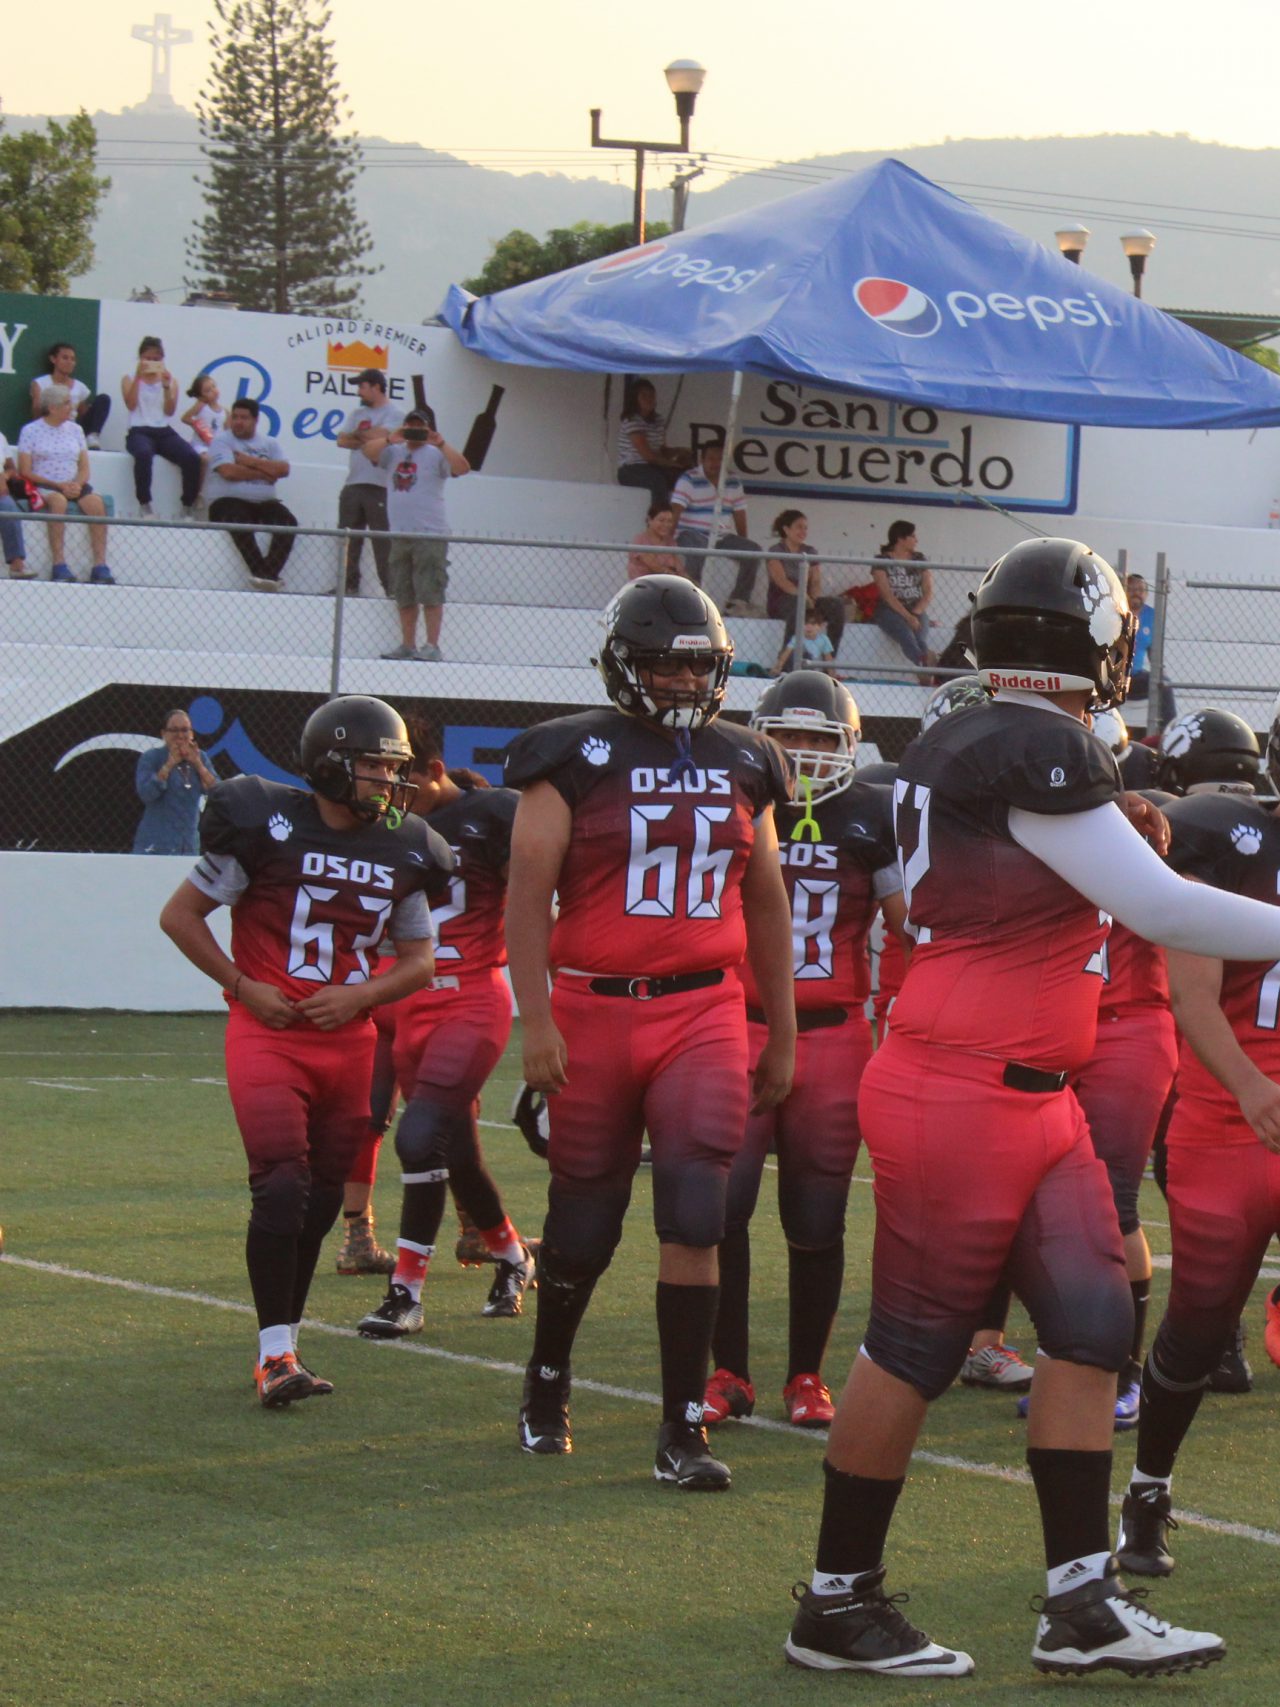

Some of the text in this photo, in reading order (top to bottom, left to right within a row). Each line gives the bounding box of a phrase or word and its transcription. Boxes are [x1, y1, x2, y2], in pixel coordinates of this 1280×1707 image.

[633, 252, 776, 295] pepsi
[946, 290, 1113, 331] pepsi
[287, 320, 428, 357] CALIDAD PREMIER
[199, 354, 346, 441] Bee
[305, 370, 406, 401] PALE
[989, 672, 1062, 690] Riddell
[302, 851, 396, 891] OSOS
[624, 804, 734, 919] 66
[777, 844, 838, 870] SOS
